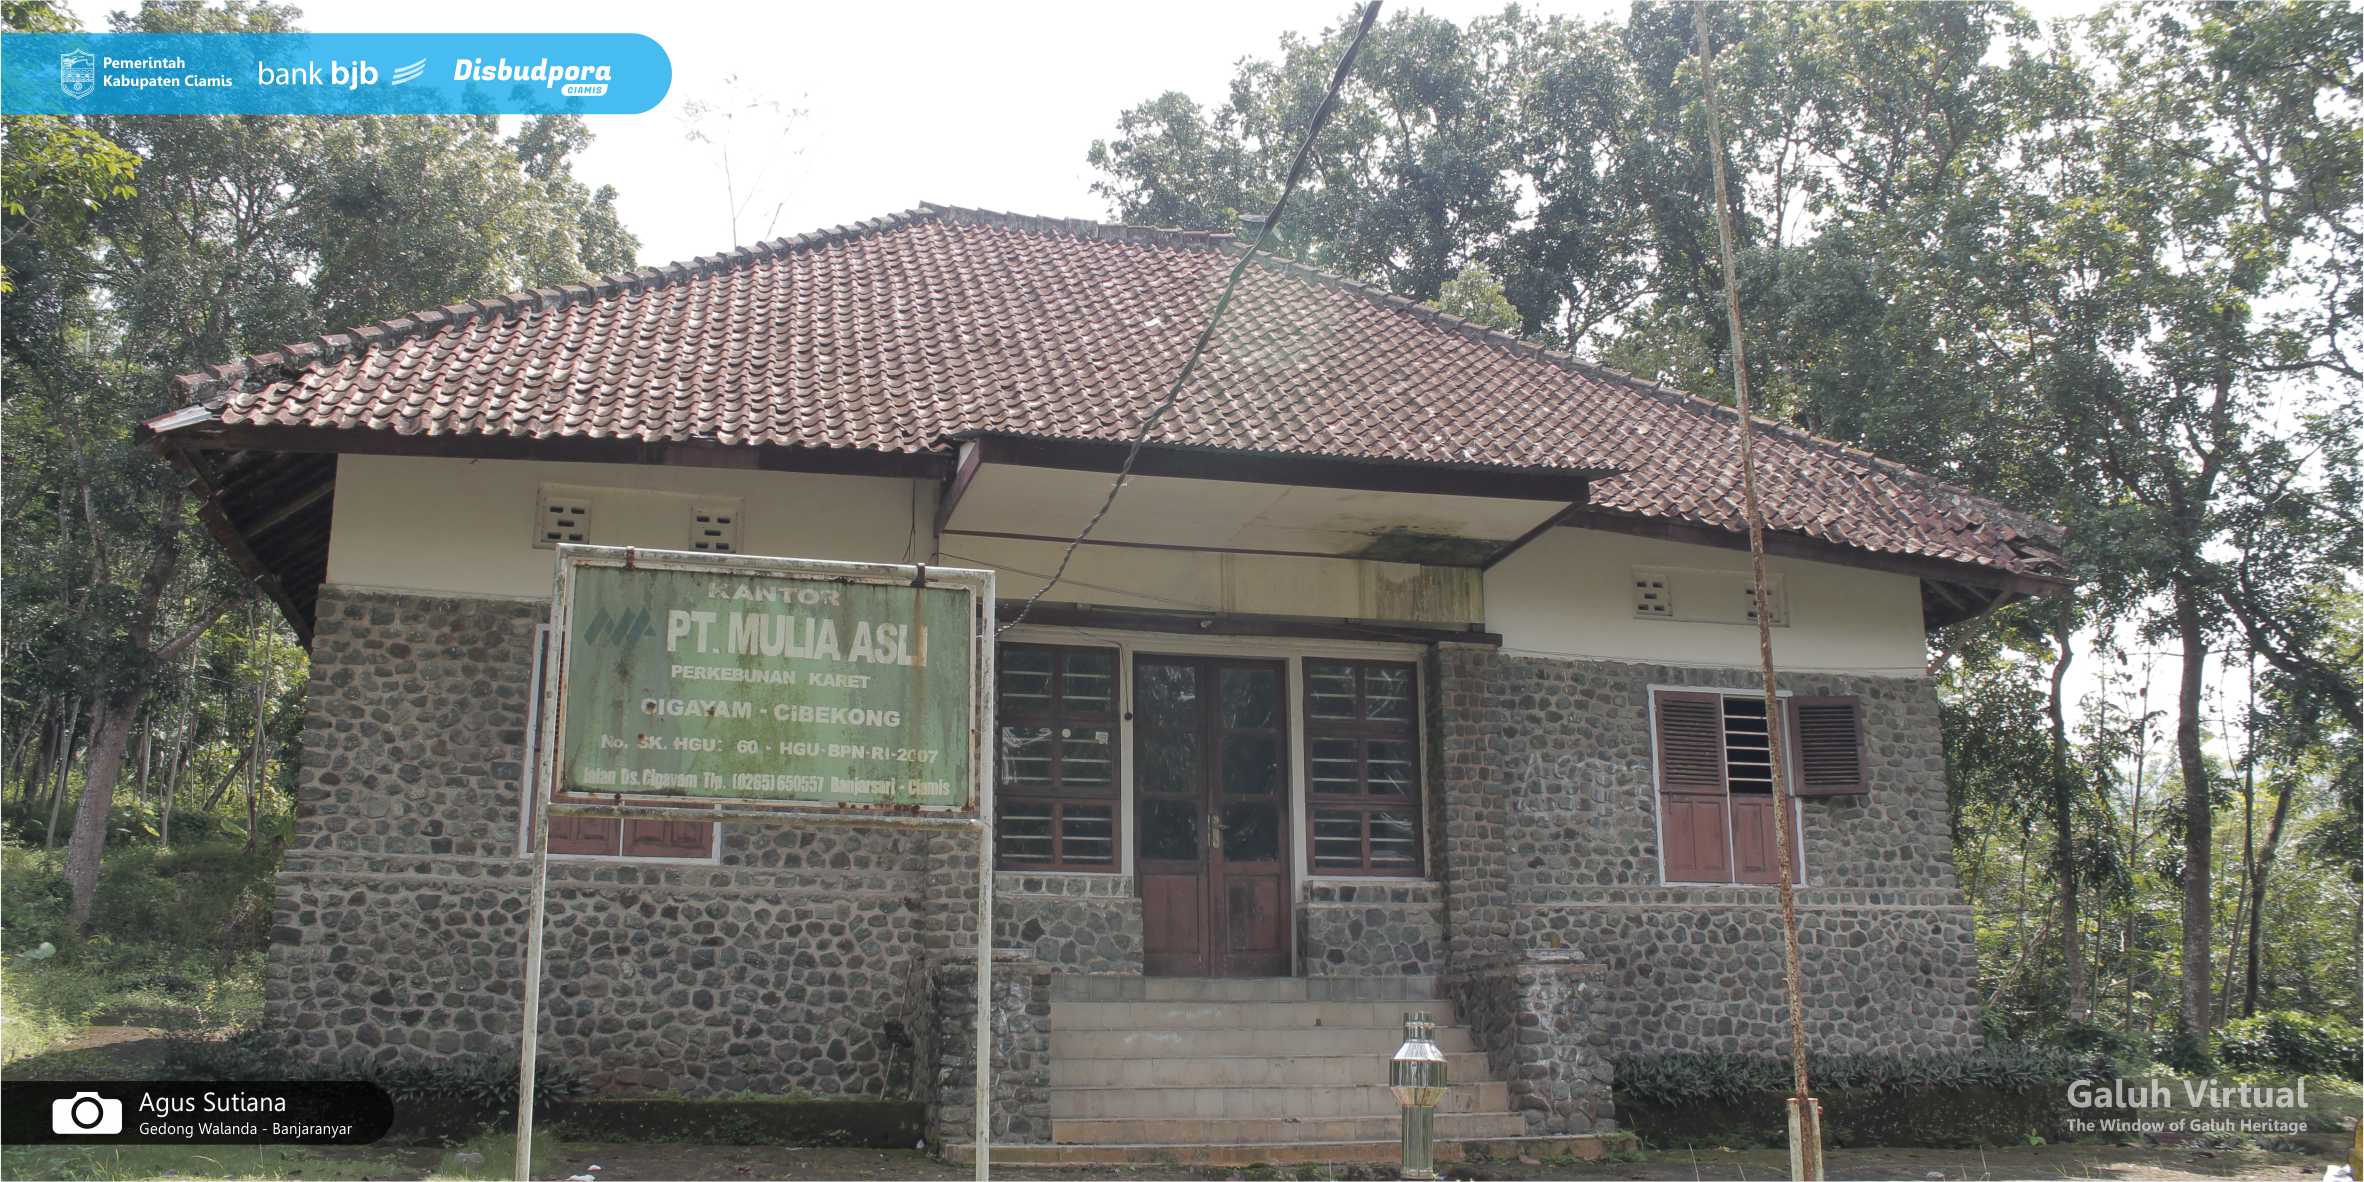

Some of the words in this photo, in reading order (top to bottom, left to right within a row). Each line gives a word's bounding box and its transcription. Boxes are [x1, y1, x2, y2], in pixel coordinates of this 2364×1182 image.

[707, 582, 841, 607] KANTOR
[667, 609, 720, 654] PT.
[727, 611, 841, 662] MULIA
[849, 621, 928, 667] ASLI
[671, 664, 796, 685] PERKEBUNAN
[808, 672, 871, 689] KARET
[640, 698, 752, 719] CIGAYAM
[601, 734, 628, 749] No.
[638, 735, 667, 750] SK.
[736, 739, 758, 754] 60
